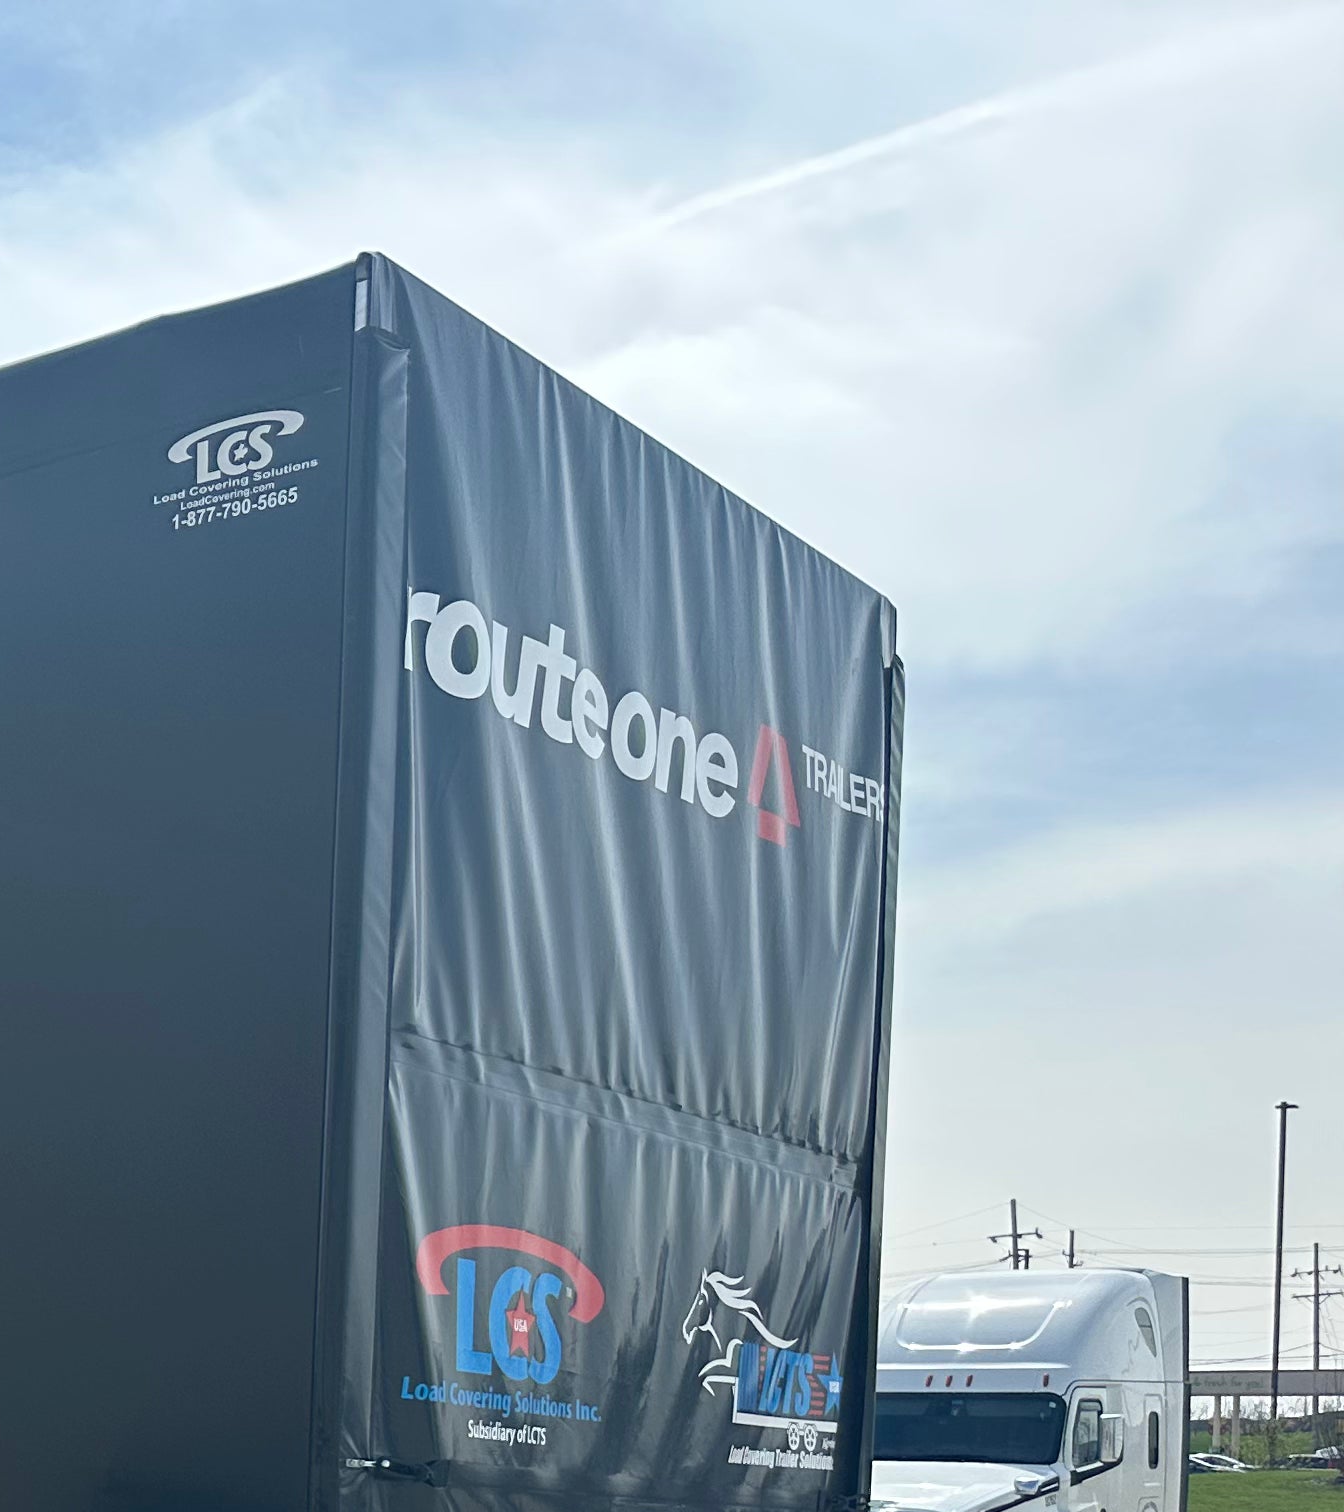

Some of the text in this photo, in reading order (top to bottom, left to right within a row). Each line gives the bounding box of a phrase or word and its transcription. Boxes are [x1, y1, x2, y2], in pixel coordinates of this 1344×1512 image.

[196, 424, 274, 484] LCS
[153, 458, 319, 505] Load Covering Solutions
[180, 481, 275, 511] LoadCovering.com
[172, 486, 299, 530] 1-877-790-5665
[404, 584, 739, 818] routeone
[456, 1257, 562, 1385] LCS
[400, 1375, 602, 1422] Load Covering Solutions Inc.
[467, 1419, 547, 1446] Subsidiary of LCTS
